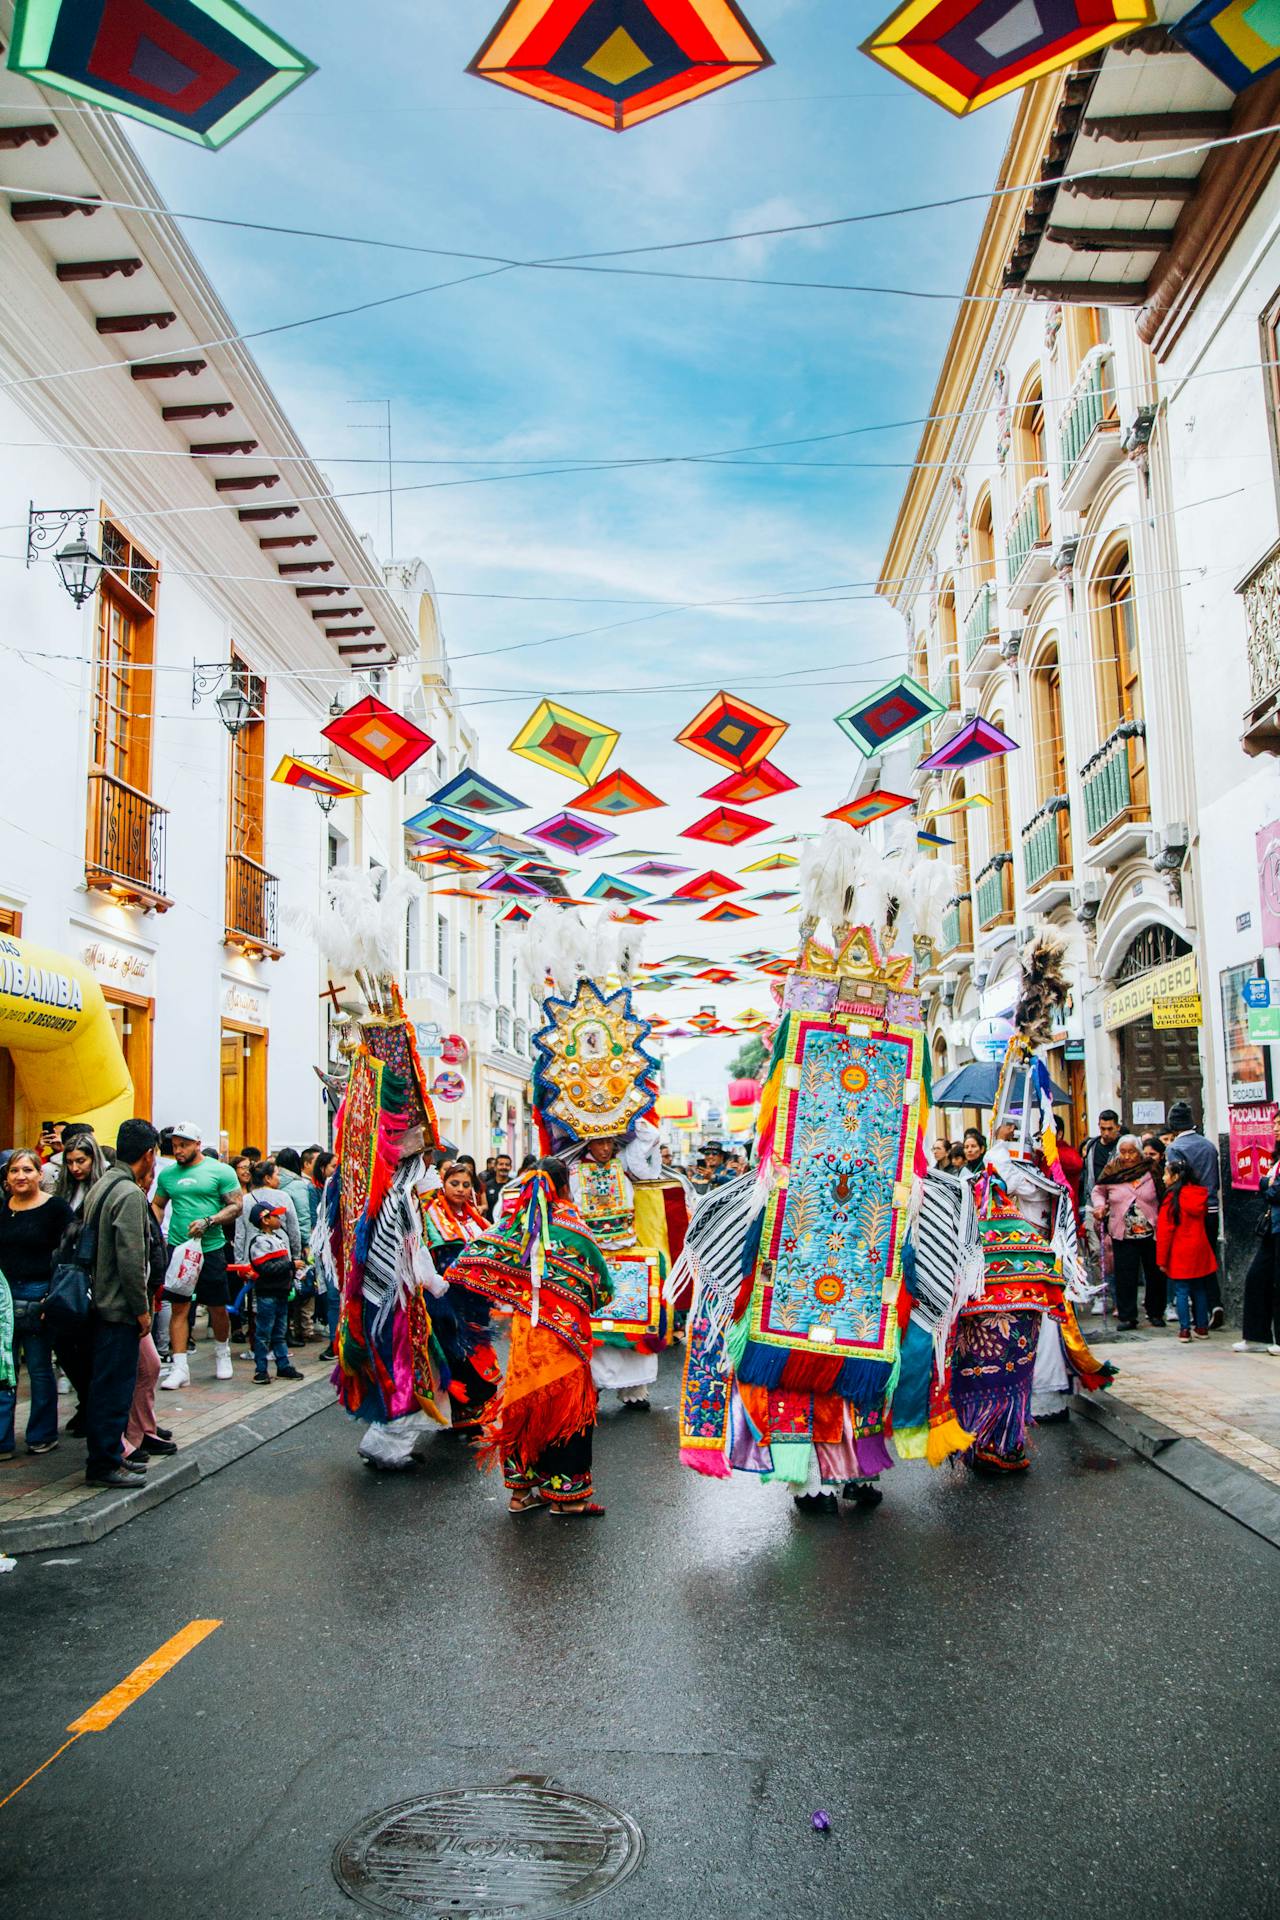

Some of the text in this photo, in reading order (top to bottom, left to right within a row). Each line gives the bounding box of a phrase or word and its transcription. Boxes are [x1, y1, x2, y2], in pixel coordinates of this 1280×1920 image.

[108, 951, 119, 969] de
[0, 957, 82, 1012] IBAMBA
[1111, 966, 1191, 1015] PARQUEADERO
[23, 1011, 35, 1023] SI
[32, 1013, 77, 1032] DESCUENTO
[1233, 1087, 1264, 1100] PICCADILLY
[1231, 1107, 1271, 1123] PICCADILLY
